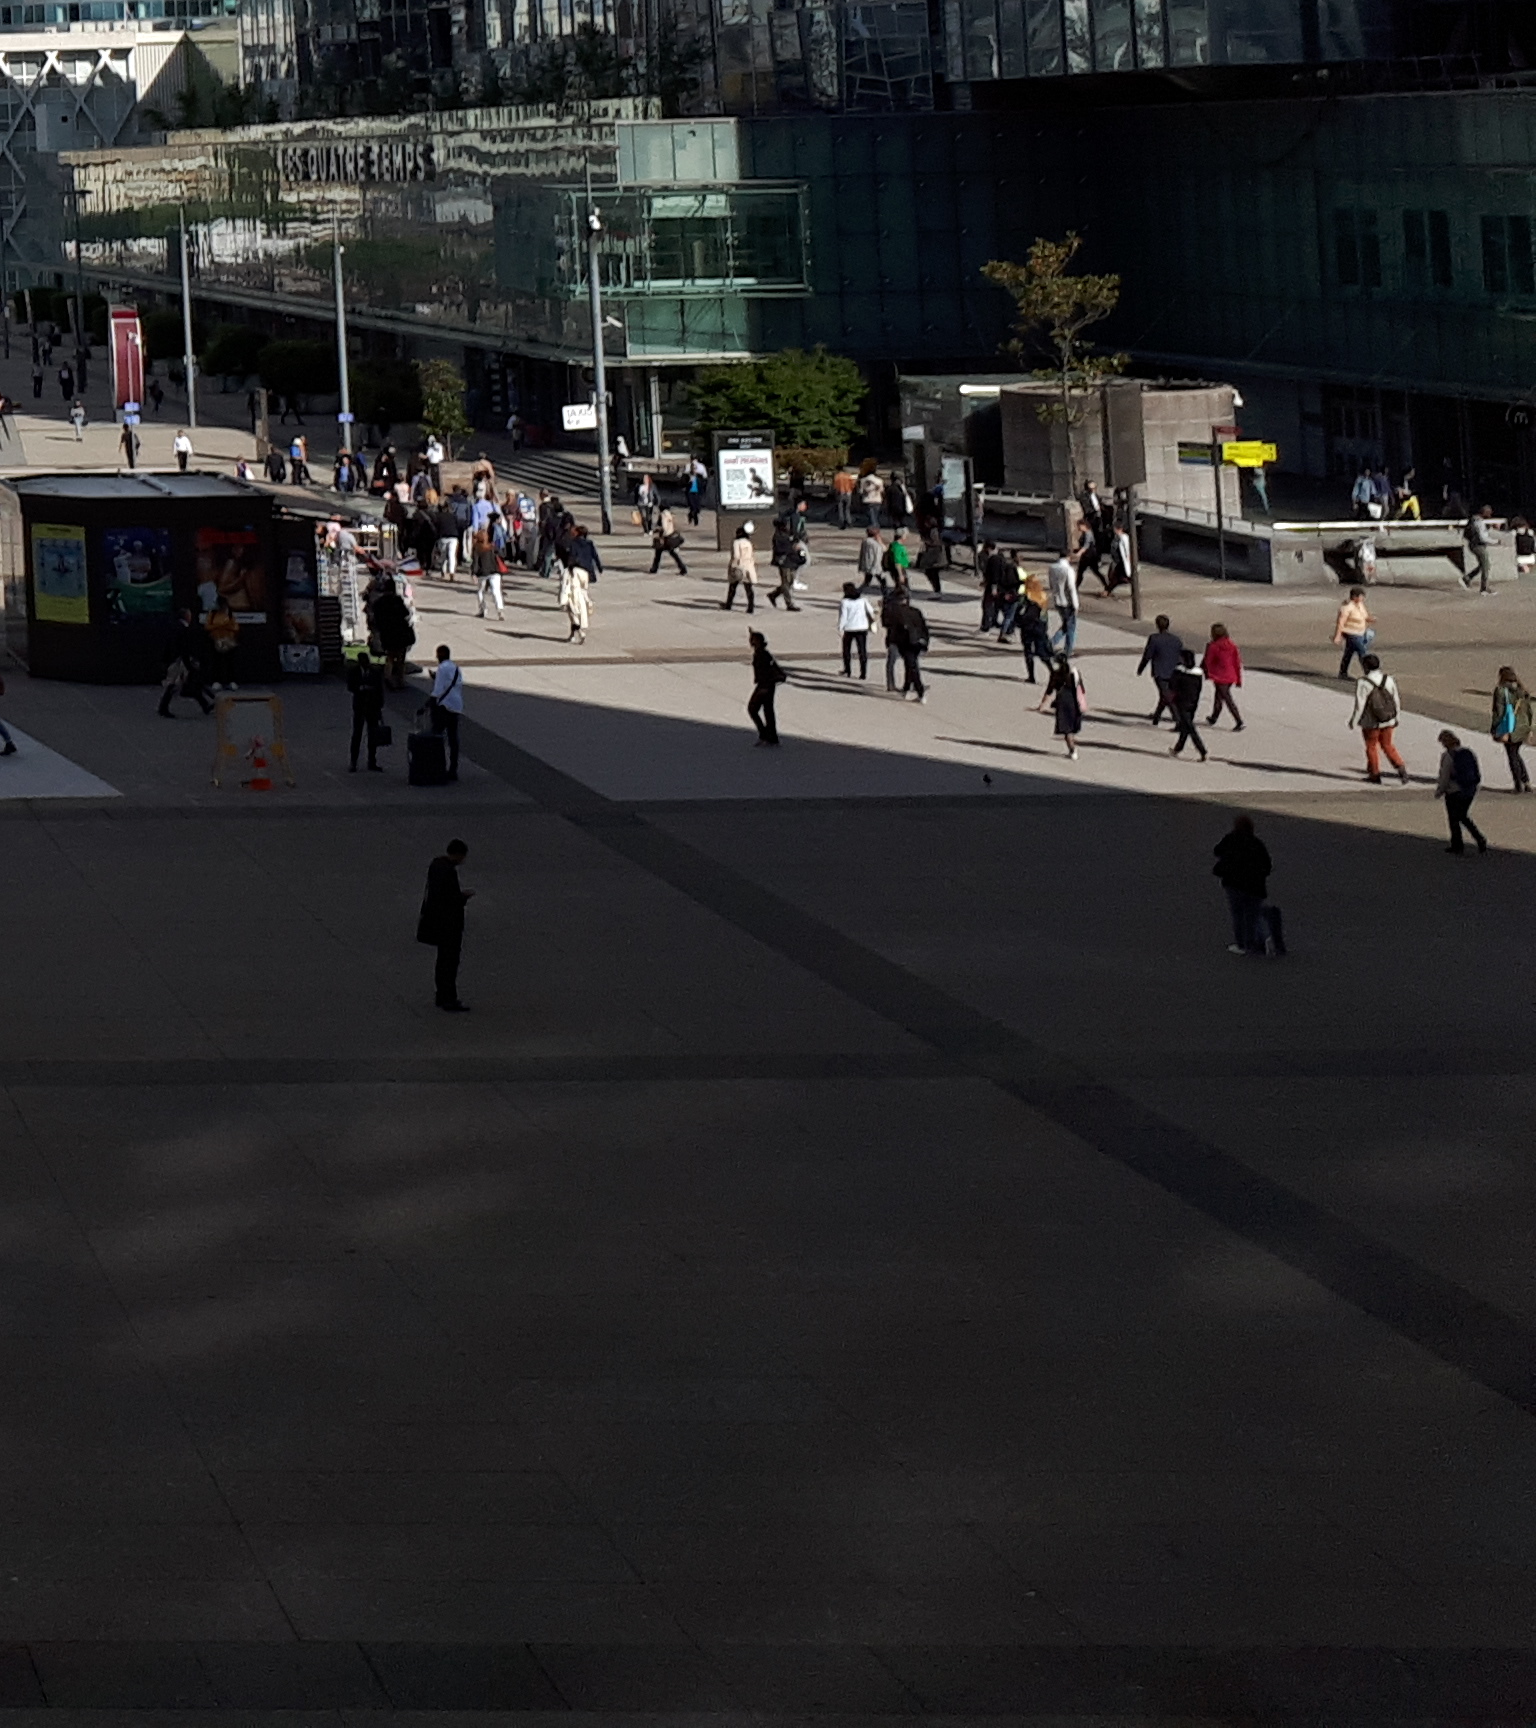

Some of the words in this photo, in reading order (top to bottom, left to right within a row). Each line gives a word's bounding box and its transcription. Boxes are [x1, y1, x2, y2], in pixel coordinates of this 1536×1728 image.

[277, 145, 303, 182] LES
[307, 143, 366, 183] QUATRE
[368, 142, 425, 183] TEMPS
